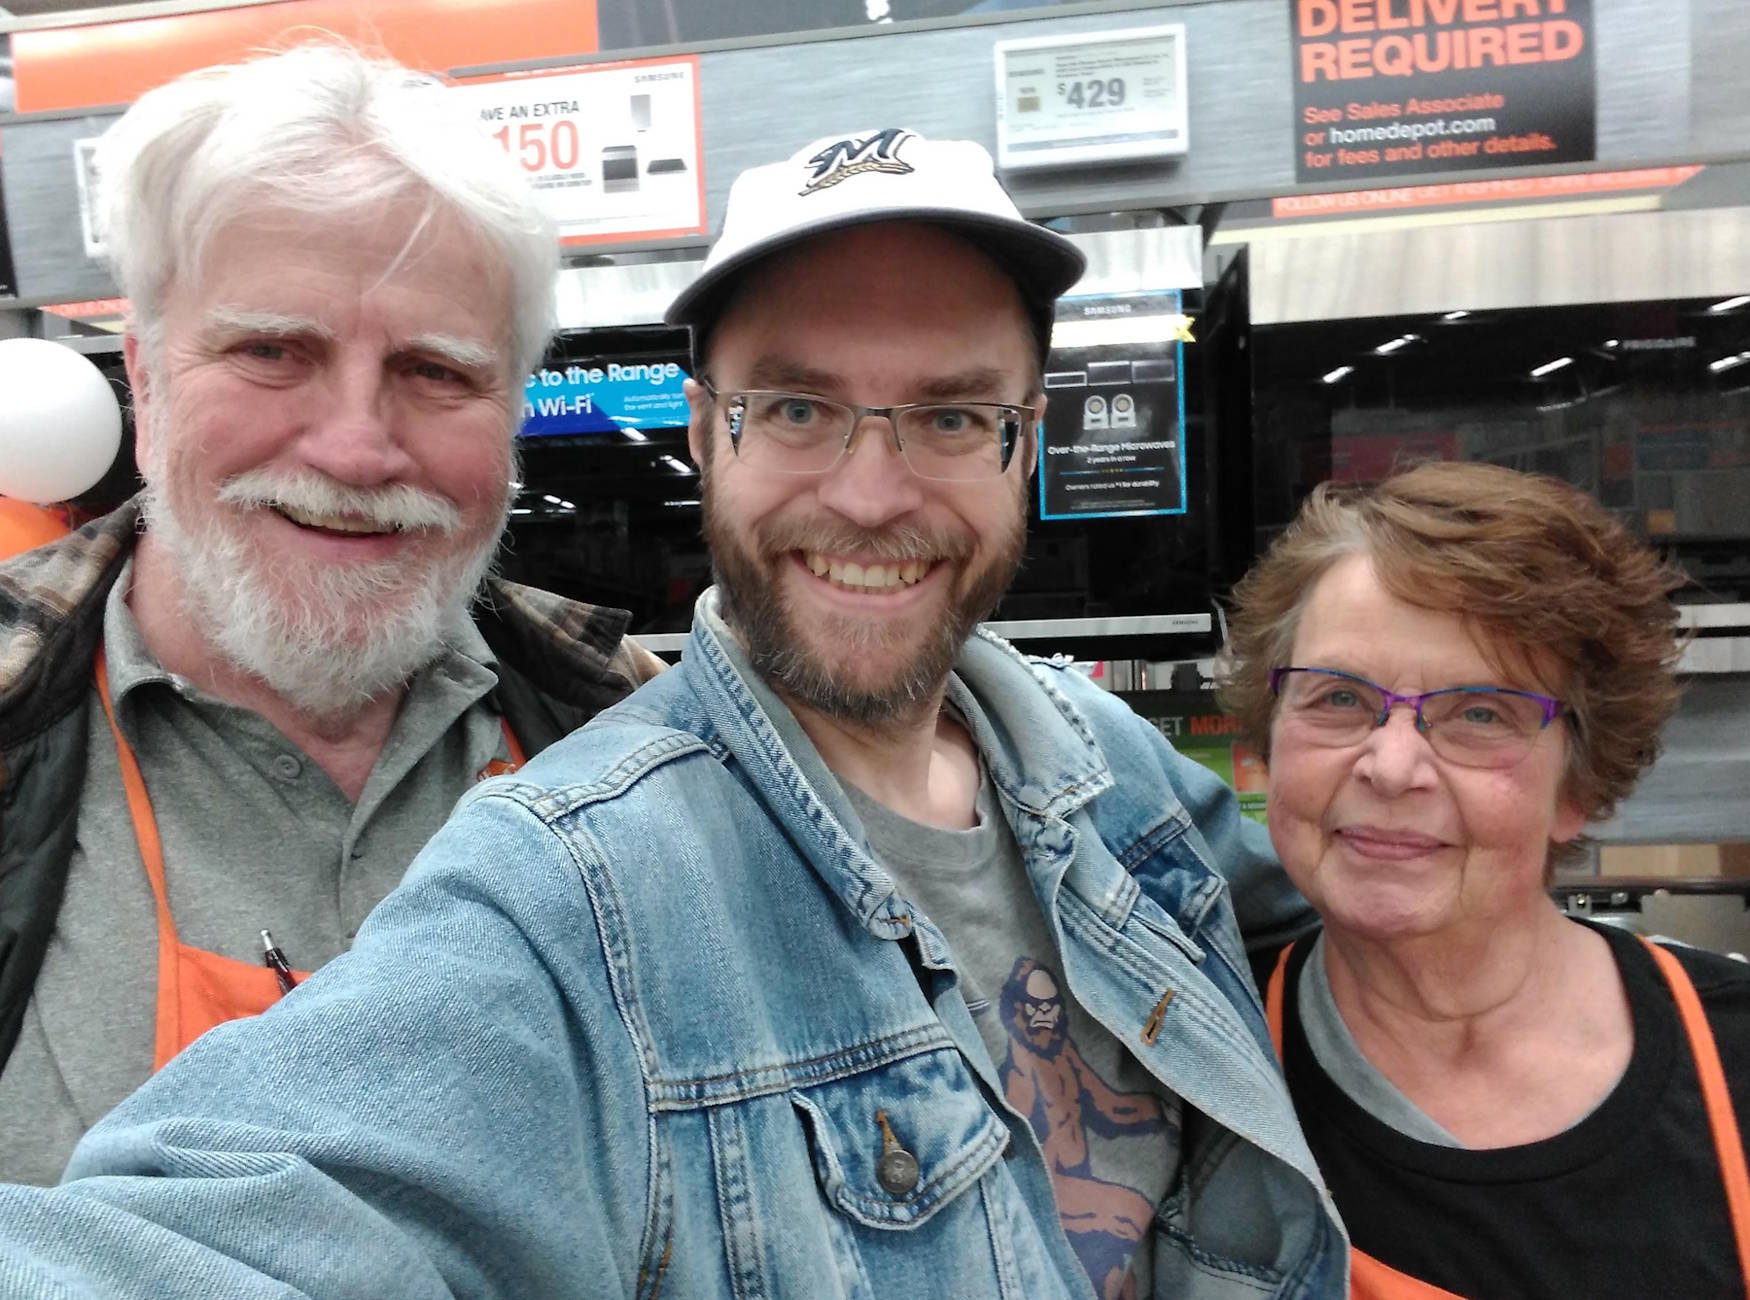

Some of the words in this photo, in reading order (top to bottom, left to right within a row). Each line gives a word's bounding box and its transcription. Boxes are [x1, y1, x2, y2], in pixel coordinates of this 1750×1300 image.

[1301, 20, 1585, 83] REQUIRED
[1057, 78, 1126, 109] $429
[480, 107, 504, 121] AVE
[510, 106, 528, 118] AN
[534, 101, 580, 117] EXTRA
[1304, 106, 1343, 124] See
[1347, 102, 1401, 120] Sales
[1405, 92, 1505, 115] Associate
[1304, 130, 1326, 146] or
[1330, 116, 1496, 144] homedepot.com
[492, 120, 580, 172] 150
[1304, 151, 1333, 168] for
[1337, 148, 1379, 165] fees
[1384, 143, 1423, 161] and
[1427, 139, 1481, 158] other
[1484, 132, 1558, 154] details.
[539, 368, 562, 387] to
[566, 366, 604, 385] the
[607, 362, 680, 386] Range
[537, 394, 592, 417] Wi-Fi
[1047, 443, 1120, 456] Over-the-Range
[1121, 440, 1176, 451] Microwaves
[1092, 457, 1110, 465] years
[1065, 483, 1090, 491] Owners
[1131, 479, 1160, 489] durability
[1189, 714, 1244, 736] MOR
